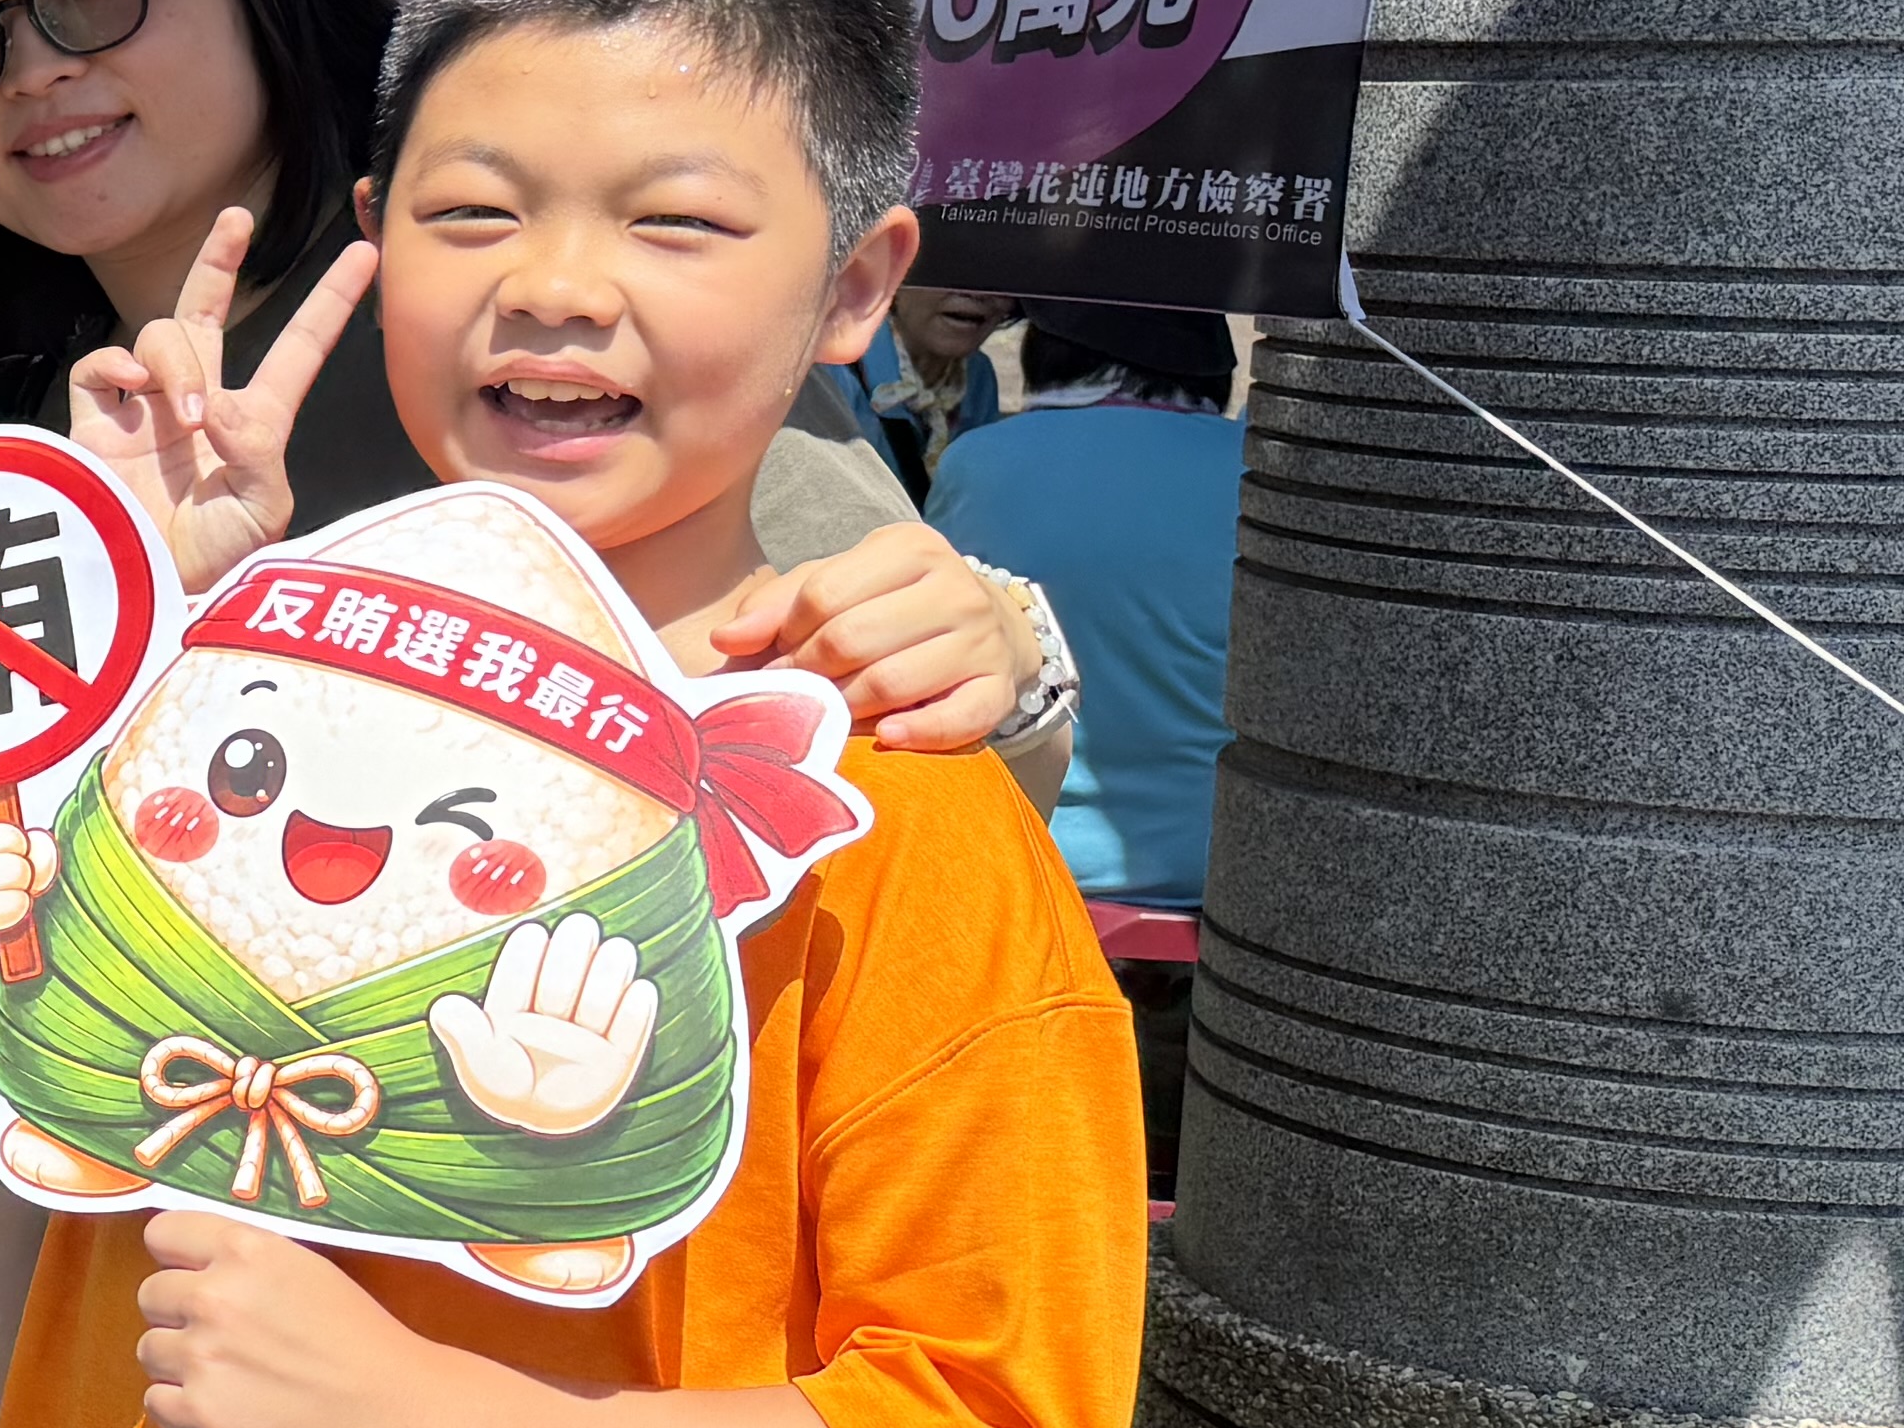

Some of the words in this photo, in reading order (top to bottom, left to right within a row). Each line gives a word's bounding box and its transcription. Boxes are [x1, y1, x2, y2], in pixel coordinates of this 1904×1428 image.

[944, 158, 1333, 223] 臺灣花蓮地方檢察署
[940, 203, 998, 223] Taiwan
[1002, 208, 1070, 228] Hualien
[1074, 213, 1140, 233] District
[1144, 218, 1260, 241] Prosecutors
[1265, 222, 1323, 246] Office
[245, 579, 651, 754] 反賄選我最行
